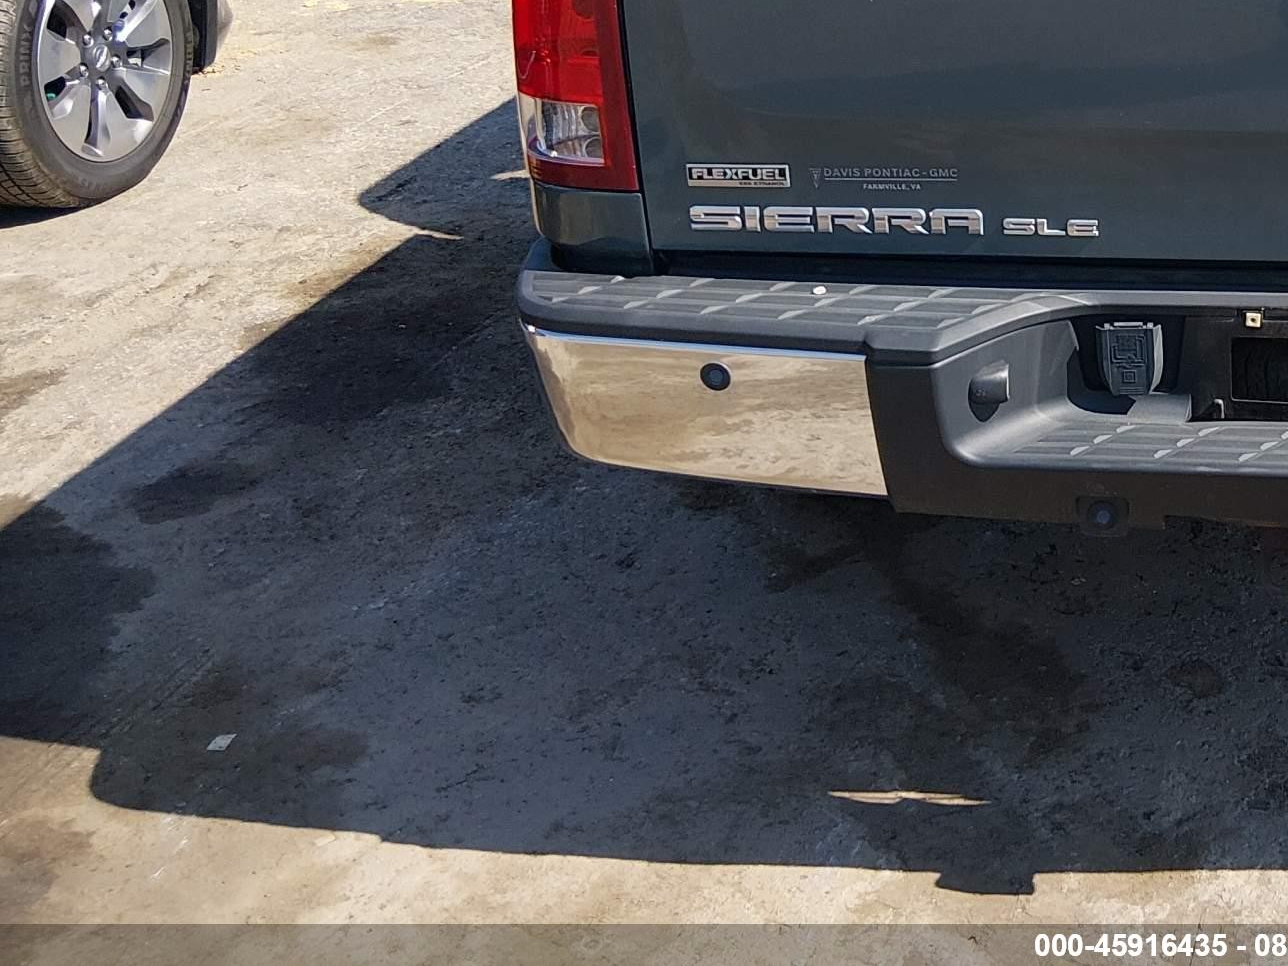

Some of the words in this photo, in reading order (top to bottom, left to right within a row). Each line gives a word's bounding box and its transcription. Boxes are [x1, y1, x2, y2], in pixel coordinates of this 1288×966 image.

[19, 23, 33, 87] PRINX
[691, 168, 785, 180] FLEXFUEL
[823, 168, 861, 177] DAVIS
[911, 183, 921, 191] VA
[689, 205, 984, 236] SIERRA
[1002, 218, 1099, 237] SLE
